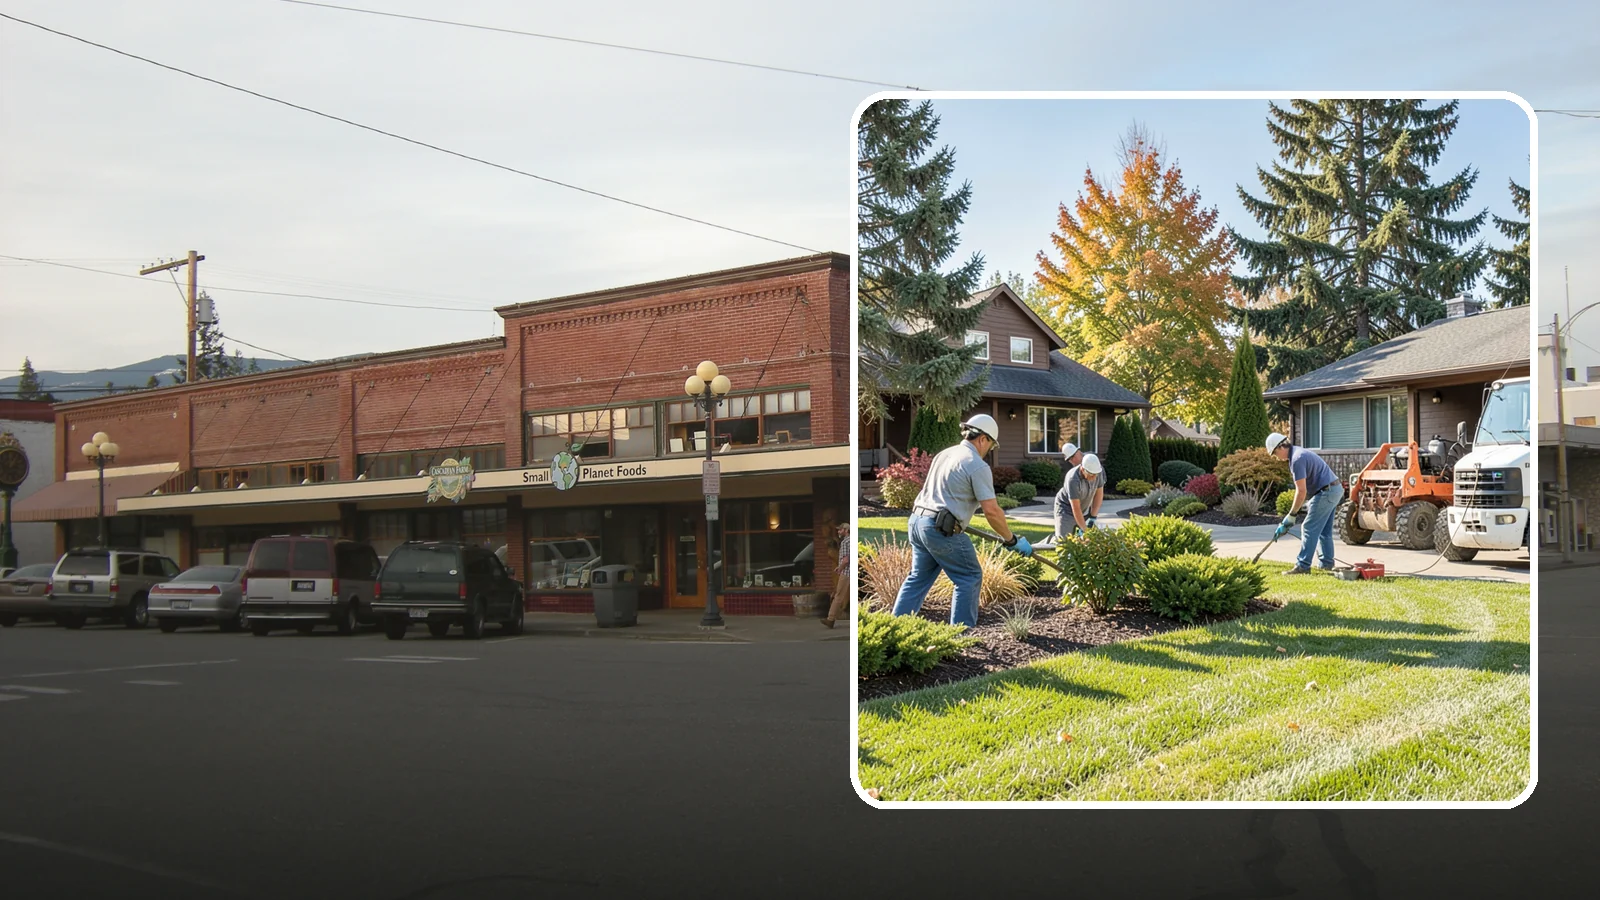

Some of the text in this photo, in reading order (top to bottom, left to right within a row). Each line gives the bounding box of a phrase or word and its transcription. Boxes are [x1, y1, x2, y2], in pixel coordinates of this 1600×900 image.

[523, 464, 647, 483] Small Planet Foods
